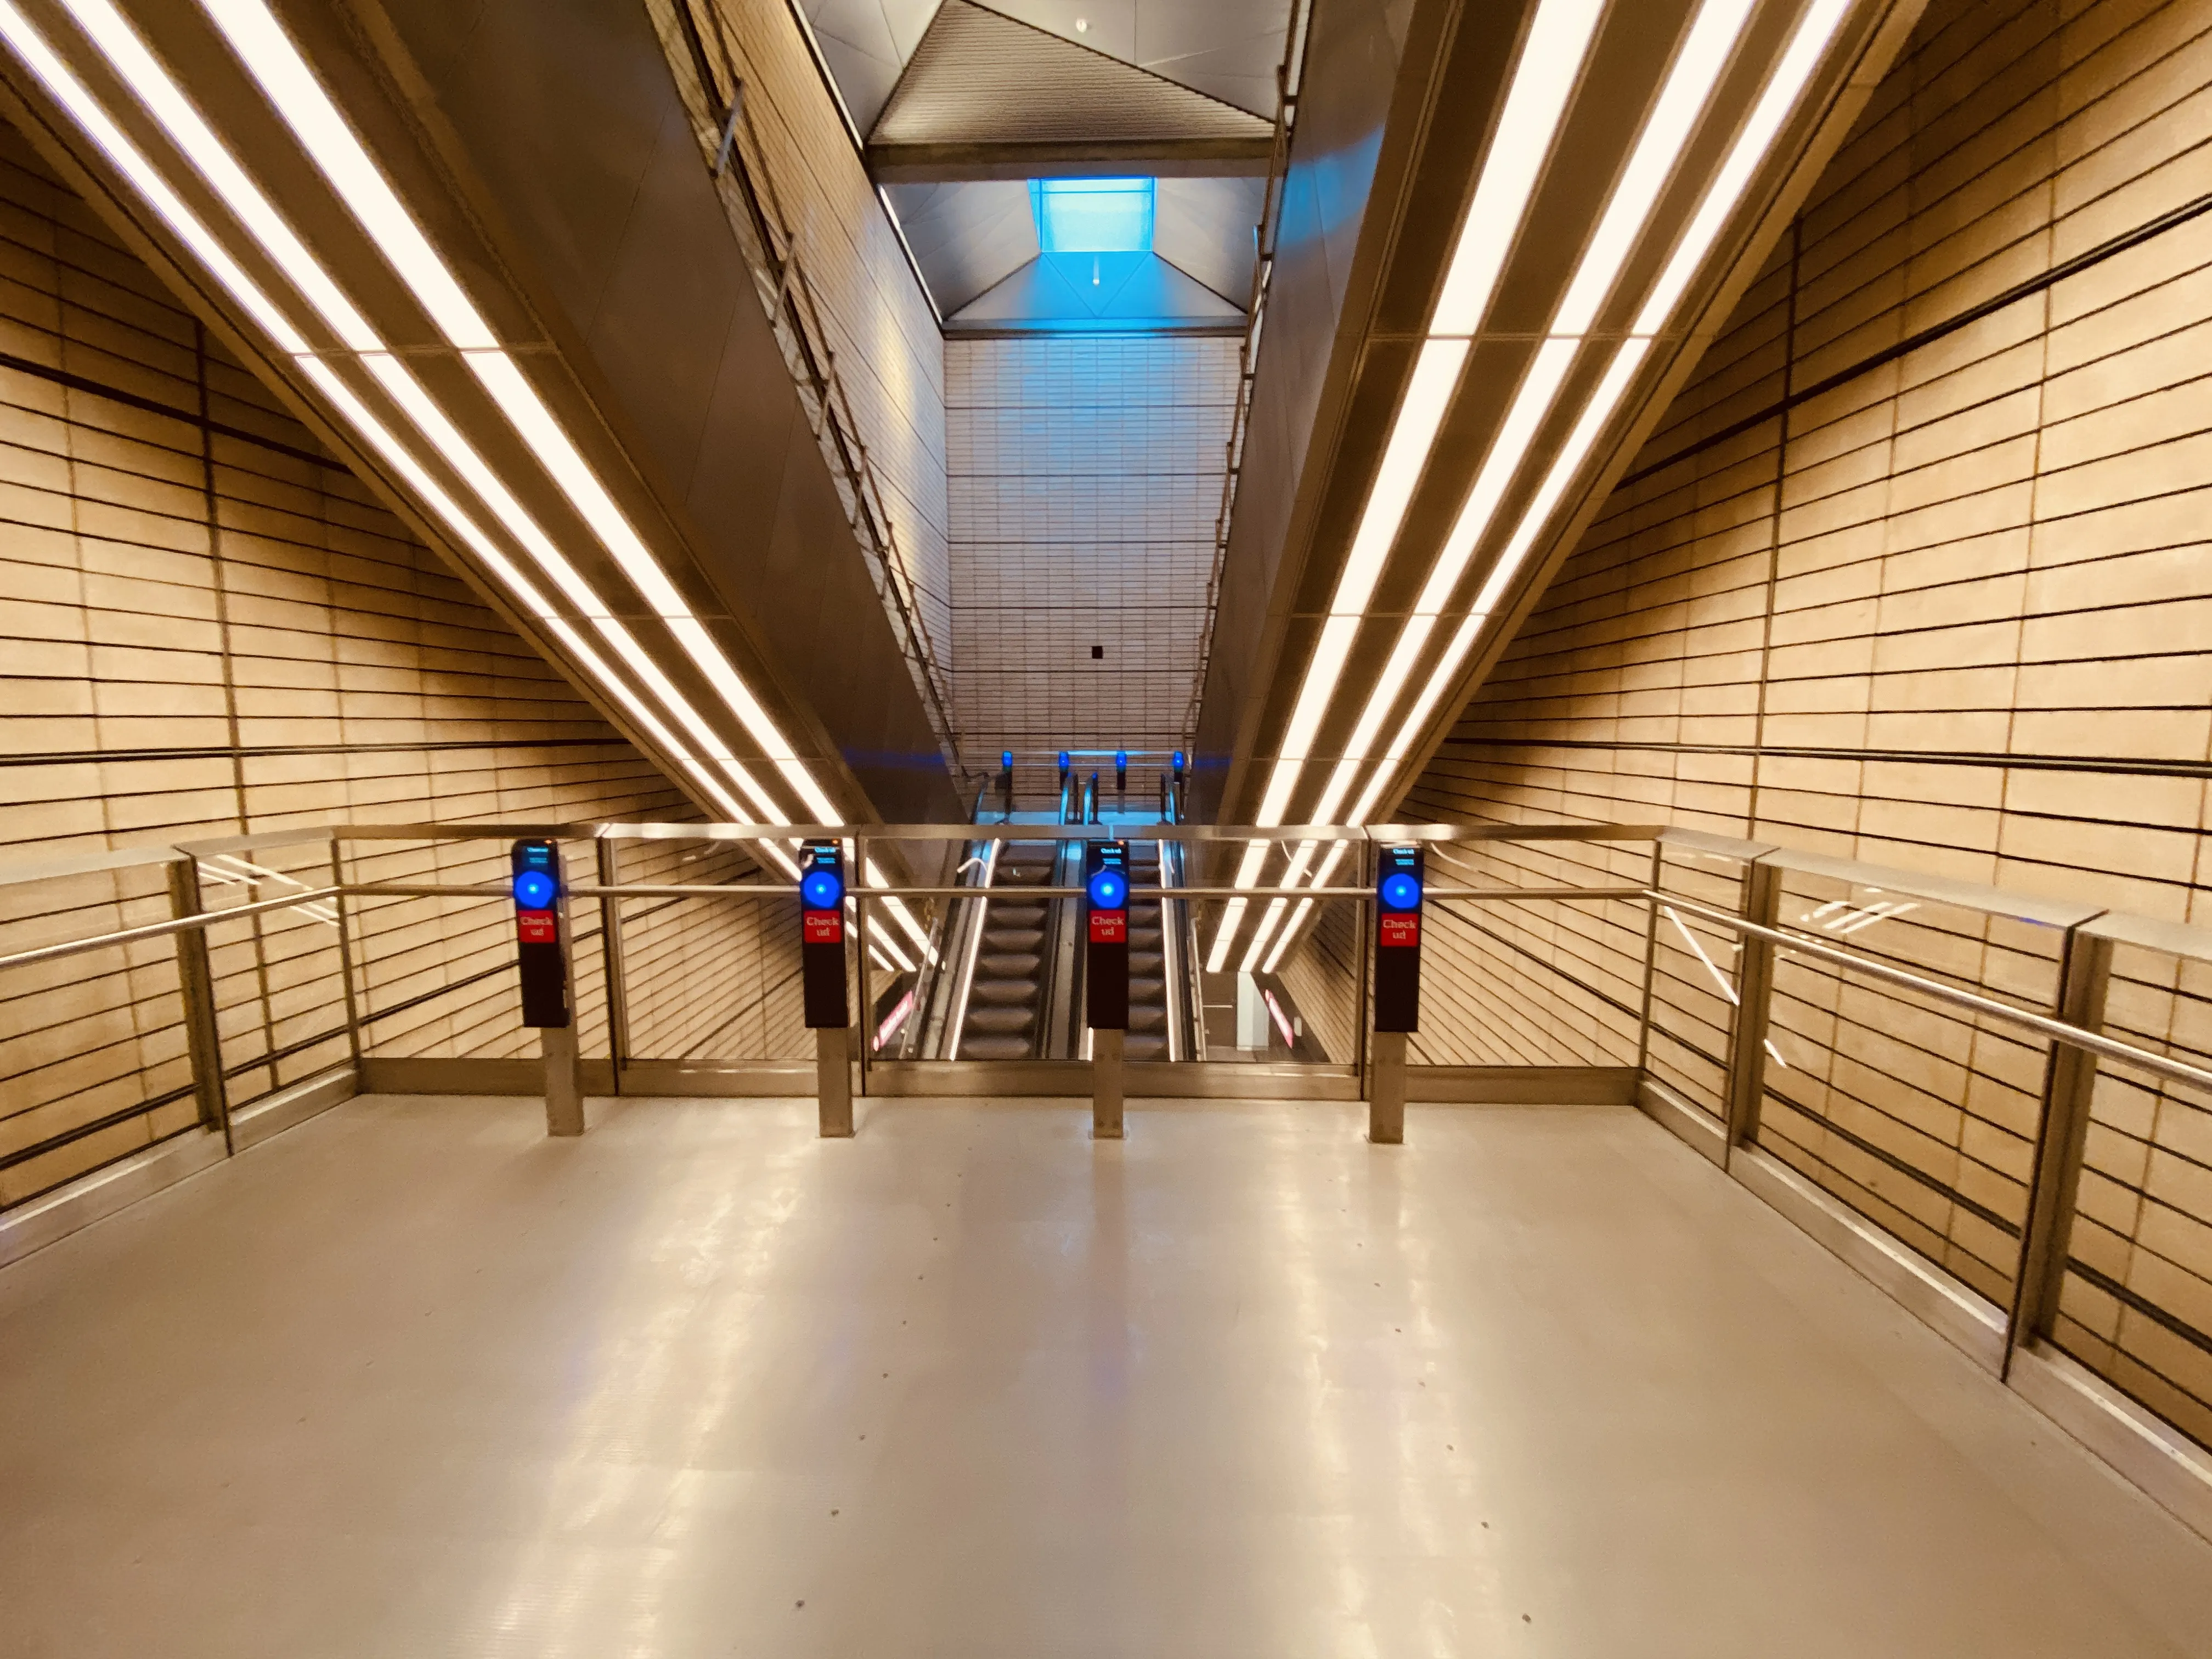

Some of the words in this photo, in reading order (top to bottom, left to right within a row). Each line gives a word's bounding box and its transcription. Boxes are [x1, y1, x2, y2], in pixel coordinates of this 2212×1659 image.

[520, 916, 554, 926] Check
[806, 916, 840, 926] Check
[1091, 916, 1124, 926] Check
[1383, 919, 1417, 929] Check
